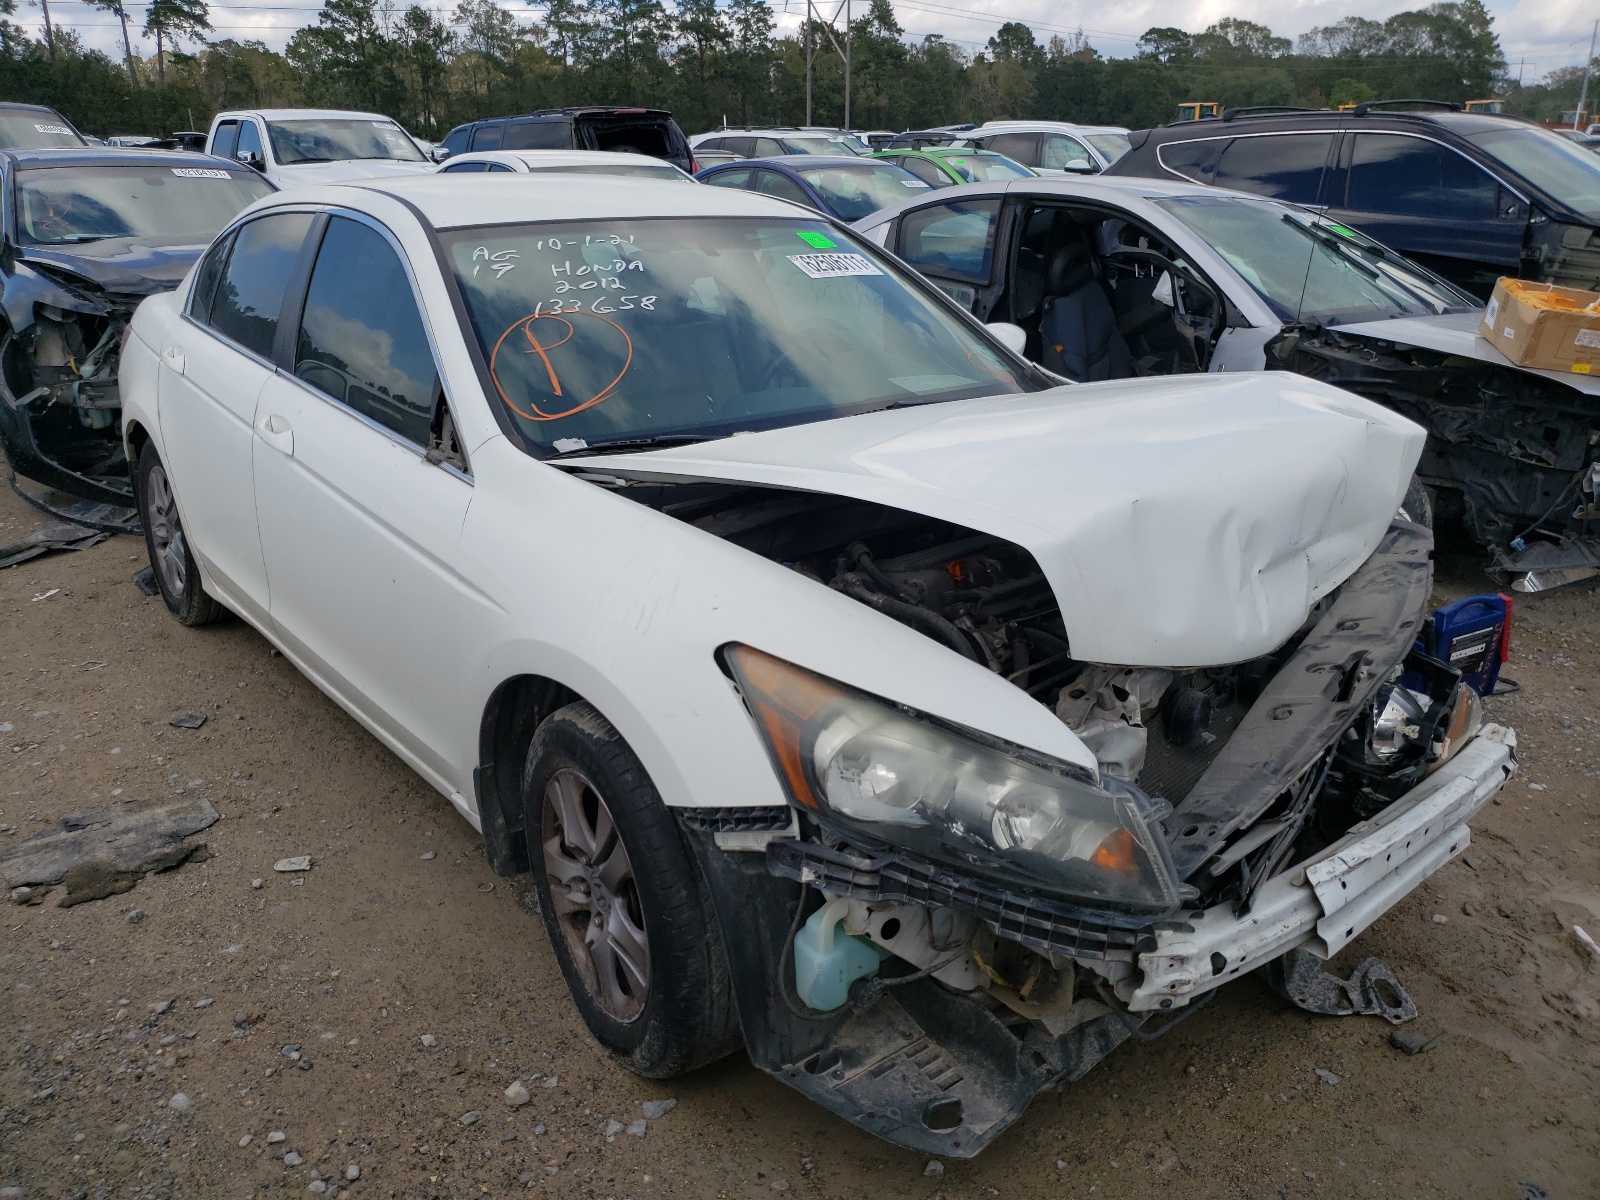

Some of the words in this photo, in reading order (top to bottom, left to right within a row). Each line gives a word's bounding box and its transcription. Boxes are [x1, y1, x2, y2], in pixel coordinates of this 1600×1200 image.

[537, 235, 635, 251] 10-1-21
[551, 259, 644, 278] HONDA
[799, 254, 869, 273] 62506111
[555, 277, 627, 294] 2012
